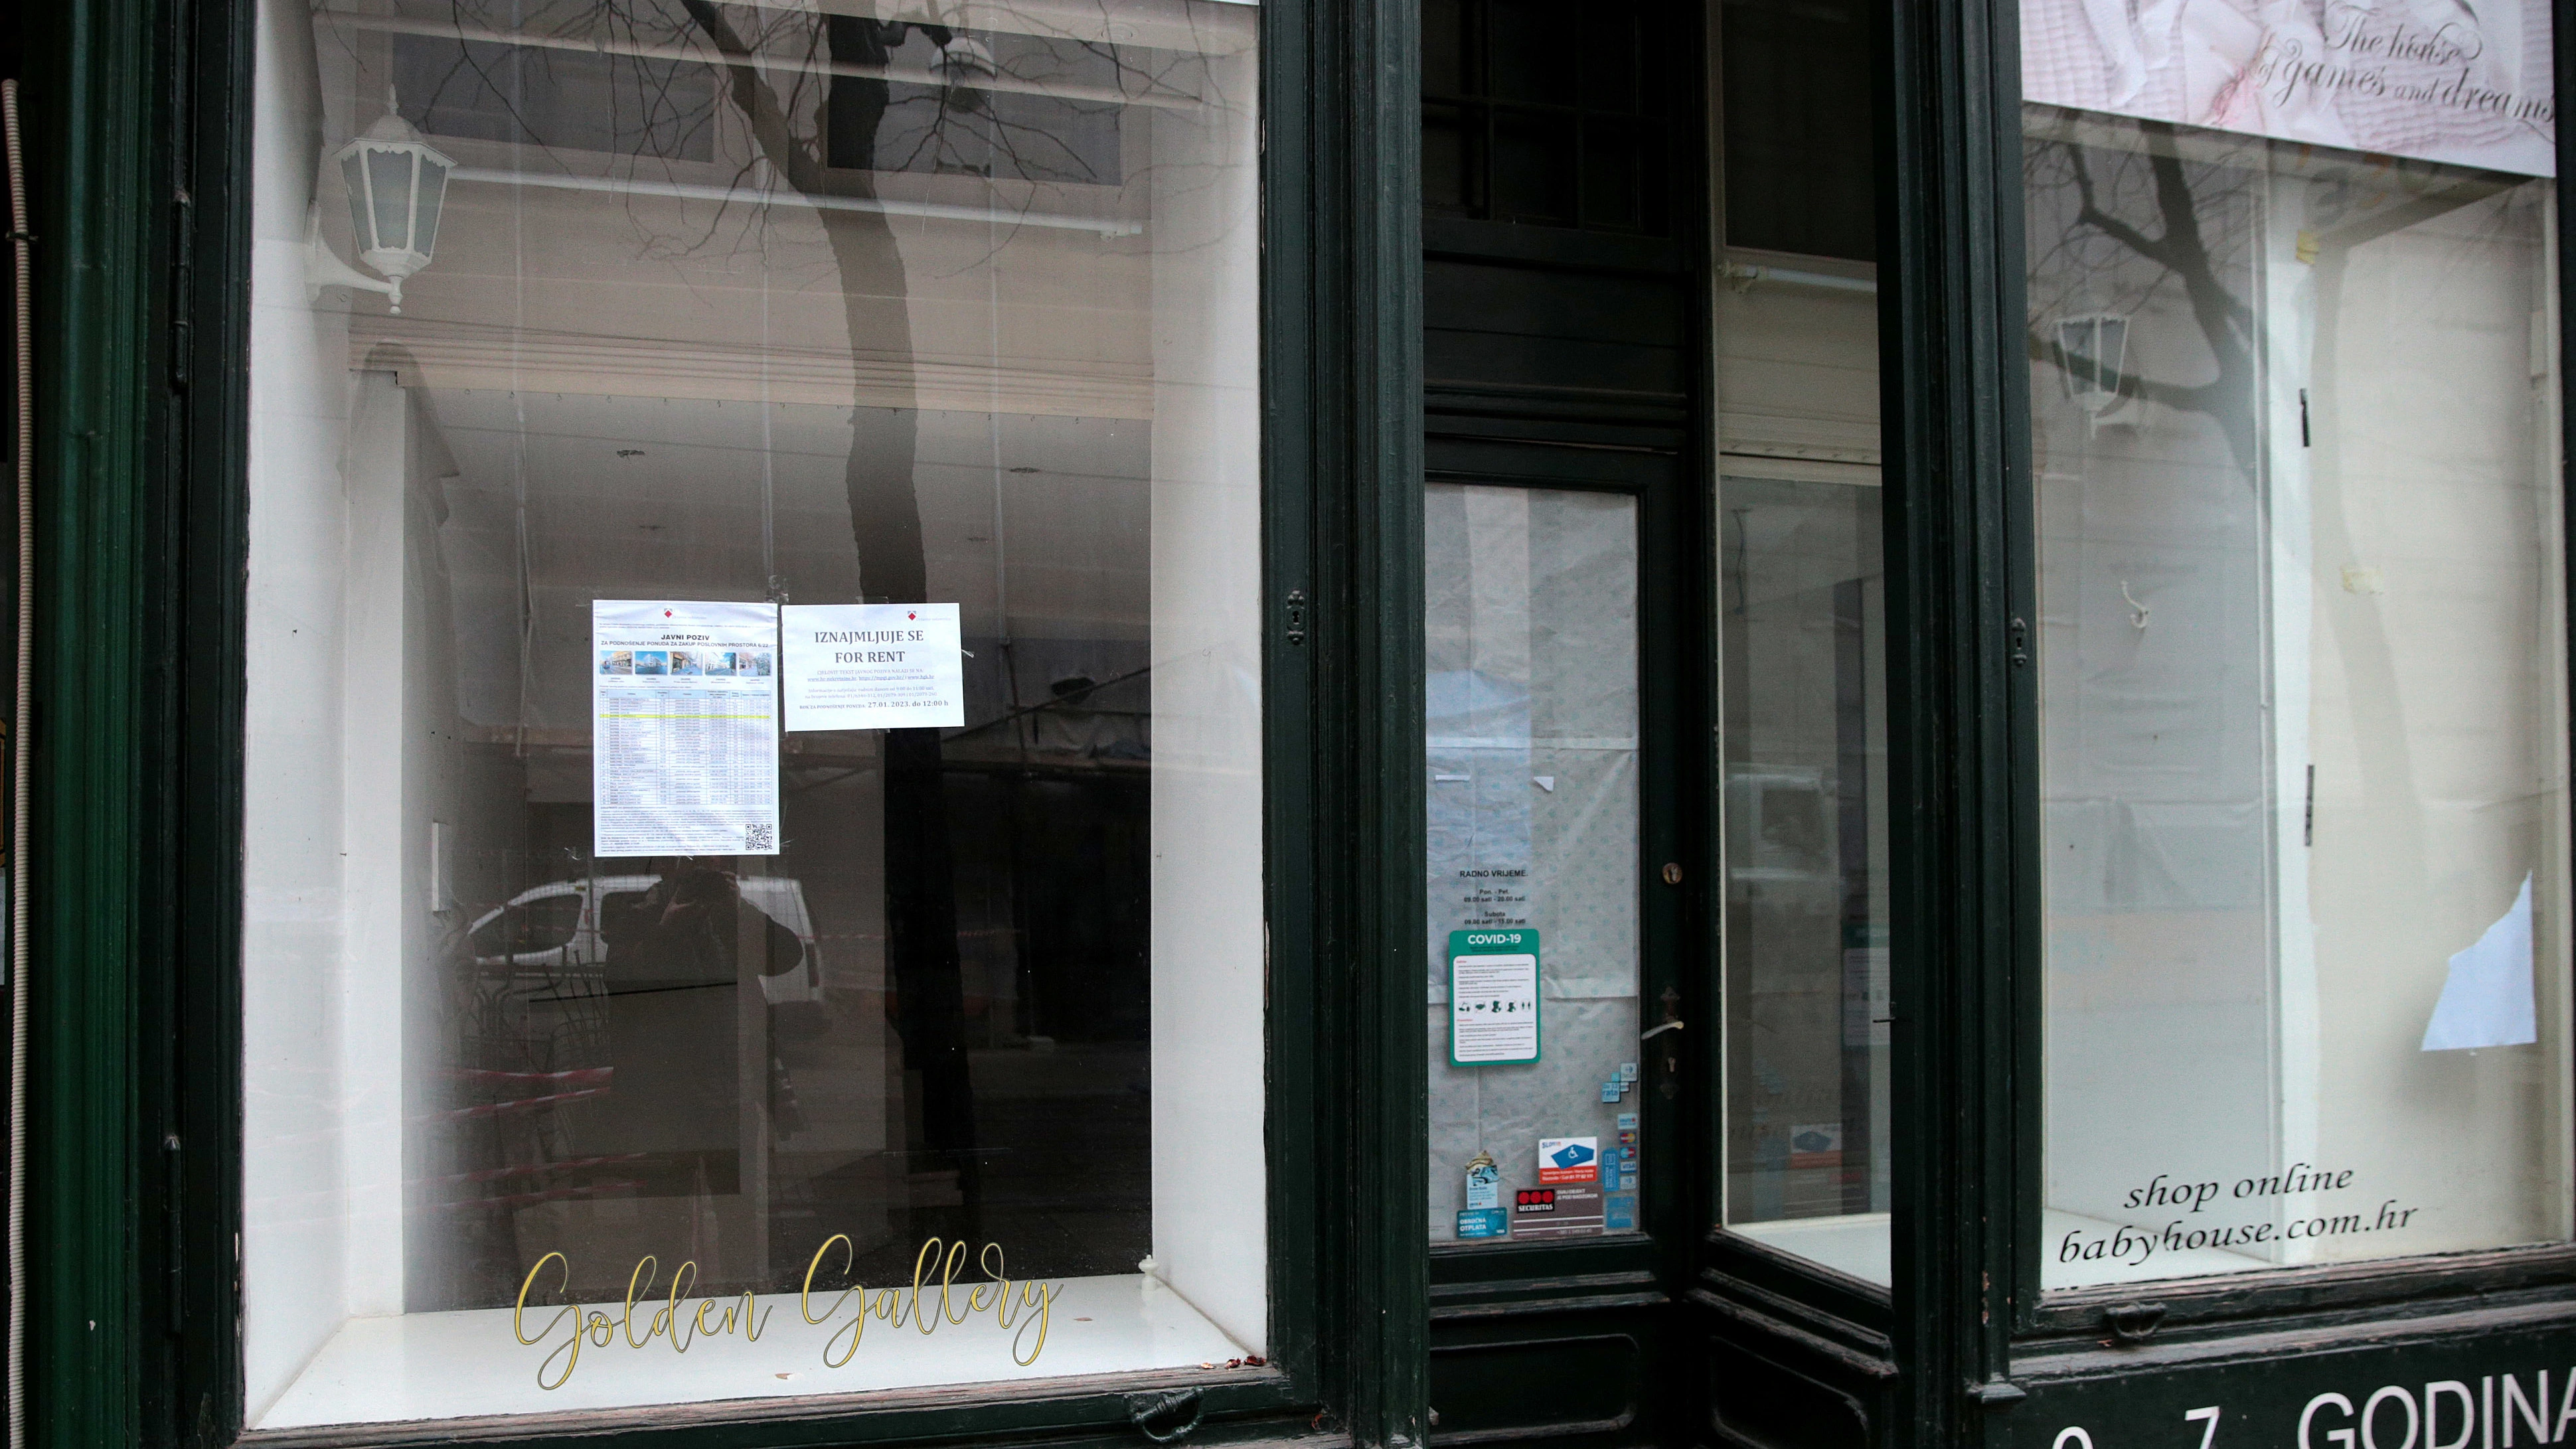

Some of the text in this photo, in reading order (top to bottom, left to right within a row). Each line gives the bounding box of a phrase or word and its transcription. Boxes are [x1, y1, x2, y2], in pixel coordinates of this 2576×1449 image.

[2324, 2, 2484, 66] The house
[2274, 58, 2386, 109] games
[2395, 78, 2437, 104] and
[2442, 67, 2555, 123] dreams
[815, 630, 924, 645] IZNAJMLJUJE SE
[835, 650, 906, 663] FOR RENT
[1467, 933, 1522, 945] COVID-19
[1518, 1203, 1554, 1212] SECURITAS
[2125, 1162, 2354, 1213] shop online
[2059, 1200, 2419, 1266] babyhouse.com.hr
[515, 1233, 1064, 1391] Golden Gallery
